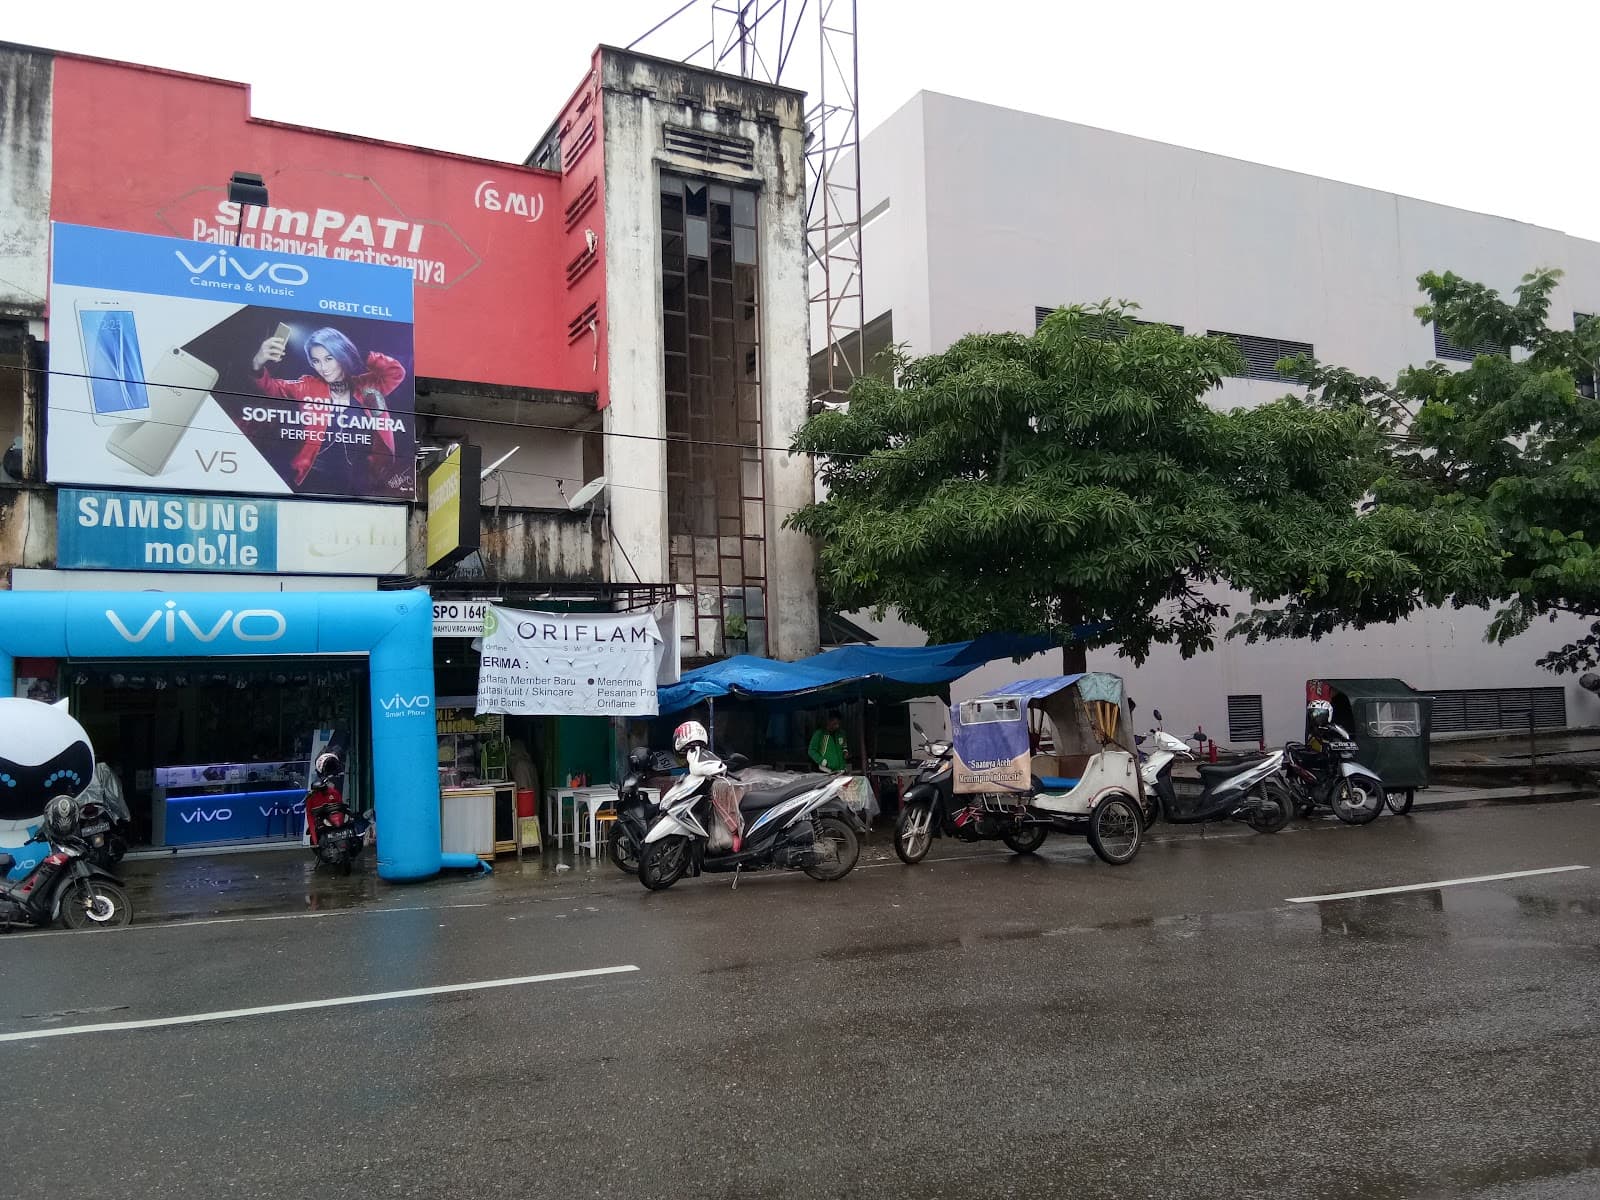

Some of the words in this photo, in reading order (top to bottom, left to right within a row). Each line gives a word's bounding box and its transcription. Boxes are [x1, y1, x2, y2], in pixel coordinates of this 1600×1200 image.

[175, 249, 309, 286] vivo
[190, 276, 241, 291] Camera
[244, 282, 254, 292] &
[258, 285, 295, 297] Music
[319, 299, 359, 313] ORBIT
[363, 304, 392, 317] CELL
[242, 406, 334, 427] SOFTLIGHT
[337, 414, 405, 433] CAMERA
[281, 428, 333, 442] PERFECT
[335, 432, 372, 445] SELFIE
[195, 449, 238, 474] V5
[78, 496, 259, 533] SAMSUNG
[480, 656, 521, 669] ERIMA
[510, 676, 551, 686] Member
[553, 676, 576, 686] Baru
[597, 677, 643, 687] Menerima
[532, 688, 574, 697] Skincare
[597, 689, 637, 698] Pesanan
[380, 693, 430, 710] vivo
[597, 699, 637, 709] Oriflame
[180, 807, 233, 823] vivo
